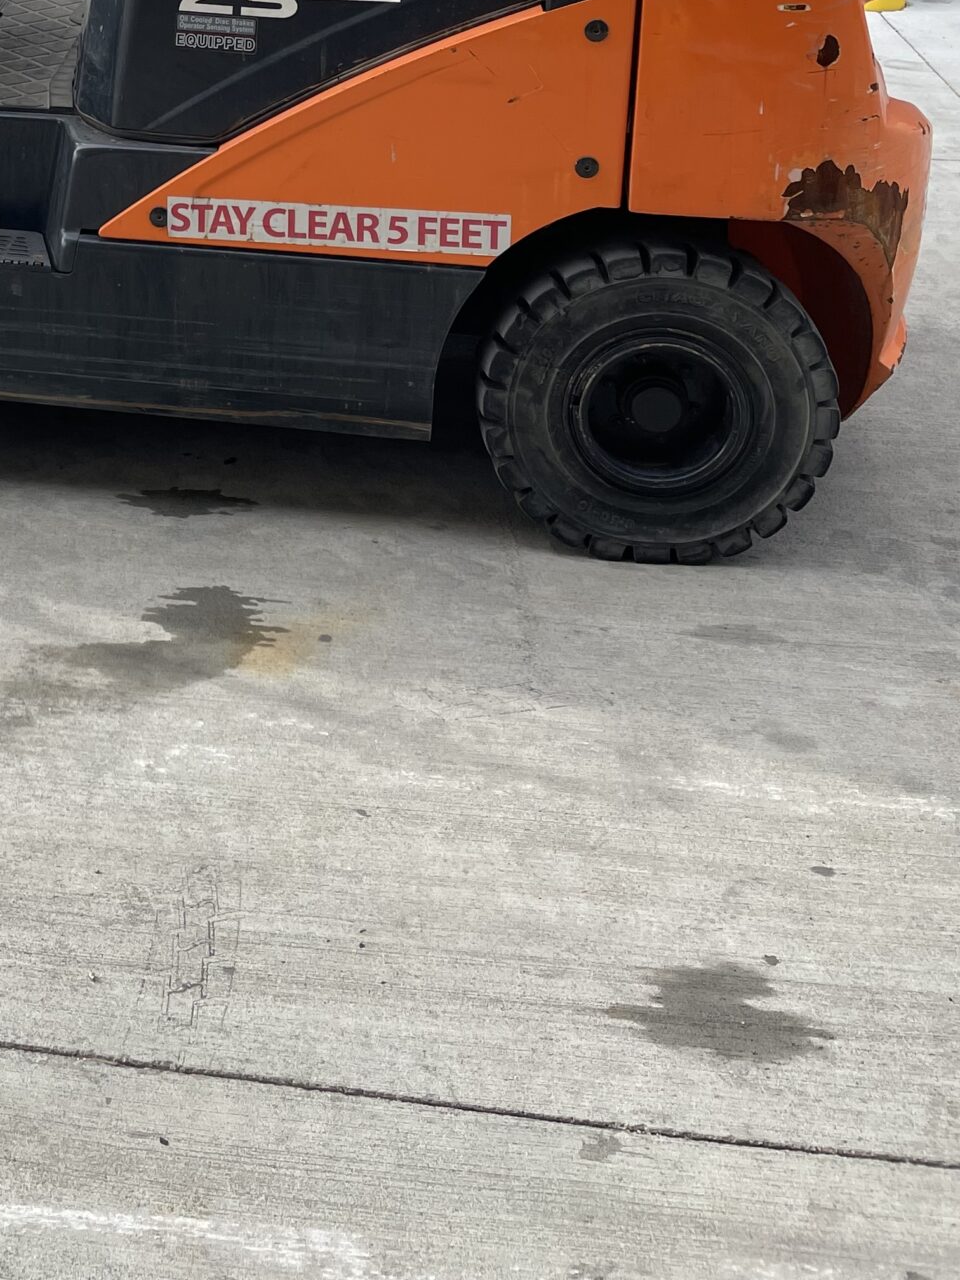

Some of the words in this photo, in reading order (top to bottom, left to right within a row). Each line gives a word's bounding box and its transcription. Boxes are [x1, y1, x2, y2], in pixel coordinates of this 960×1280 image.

[180, 21, 205, 30] Operator
[206, 23, 231, 33] Sensing
[232, 25, 255, 33] System
[191, 15, 213, 24] Cooled
[215, 17, 230, 25] Disc
[232, 19, 255, 27] Brakes
[175, 32, 256, 51] EQUIPPED
[169, 203, 255, 235] STAY
[262, 208, 380, 244] CLEAR
[387, 216, 409, 245] 5
[418, 217, 507, 249] FEET
